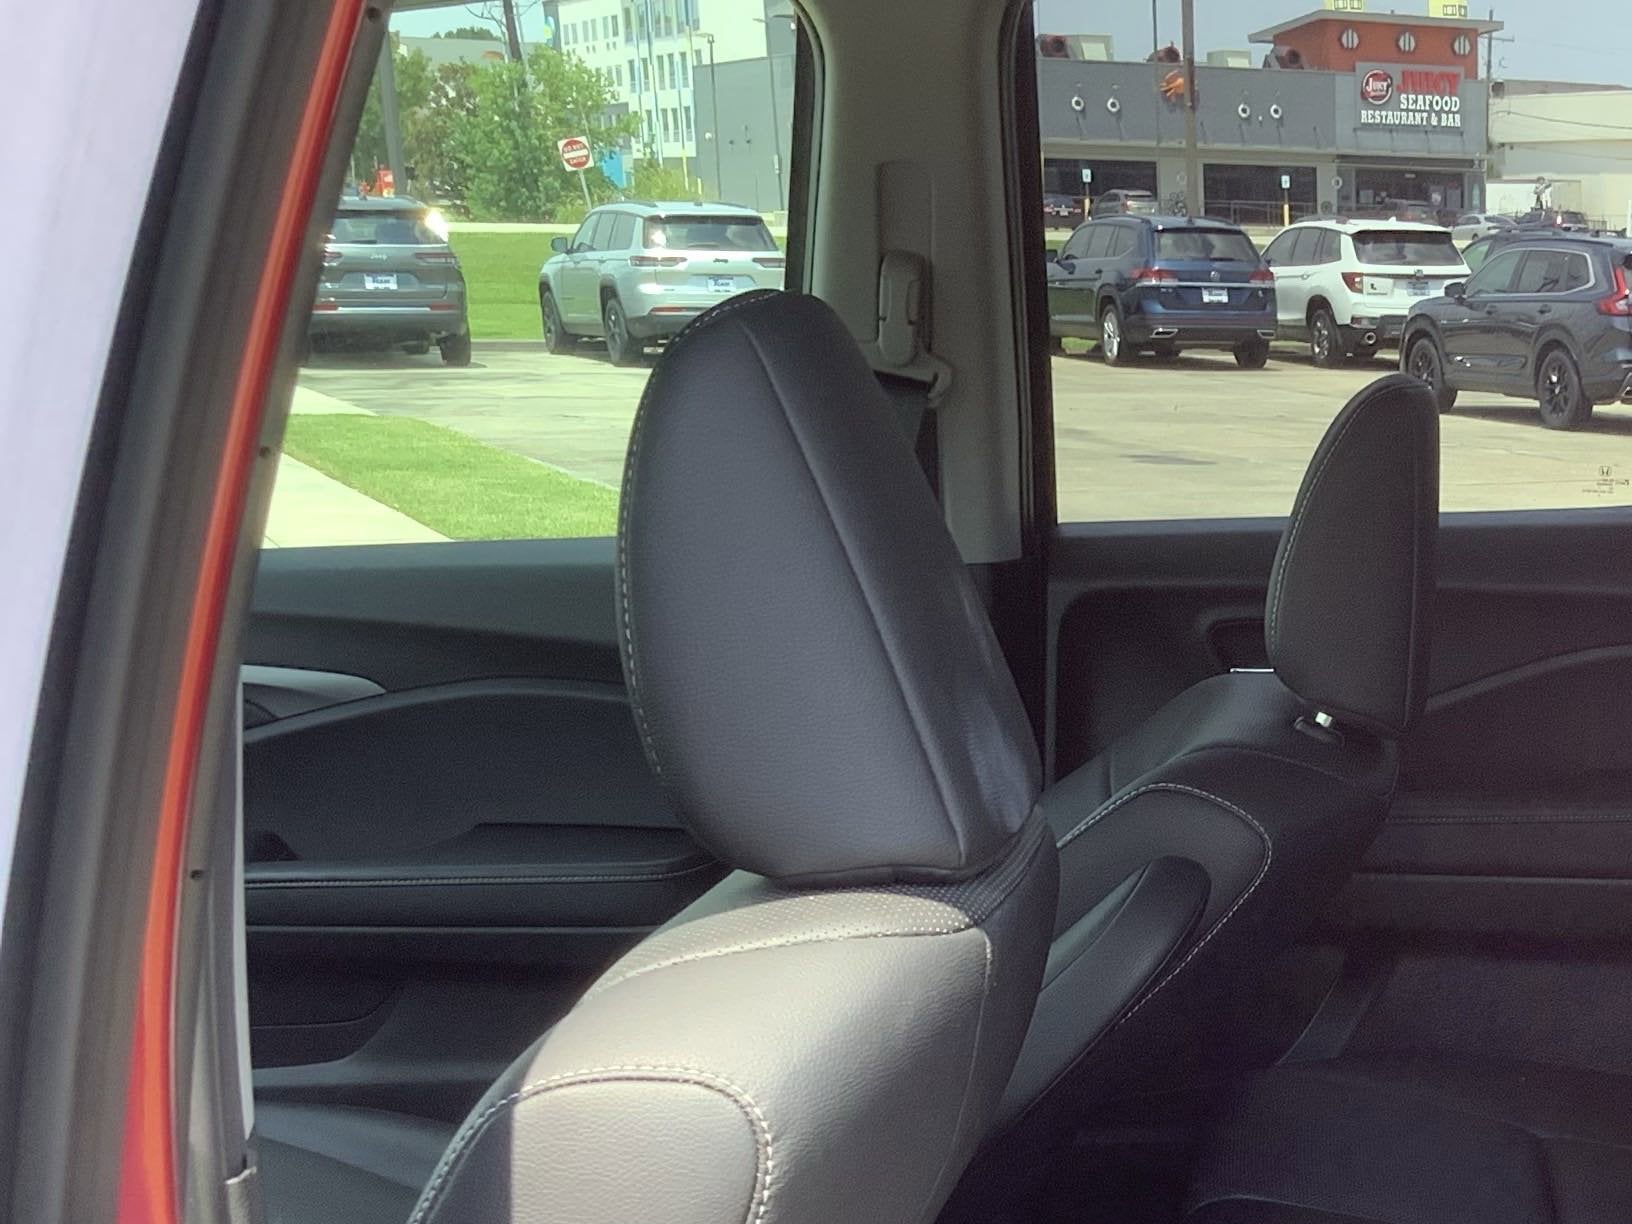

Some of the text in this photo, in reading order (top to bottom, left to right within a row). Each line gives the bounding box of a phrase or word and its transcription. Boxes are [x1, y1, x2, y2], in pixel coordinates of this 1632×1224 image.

[1400, 93, 1460, 111] SEAFOOD
[1360, 110, 1461, 127] RESTAURANT & BAR
